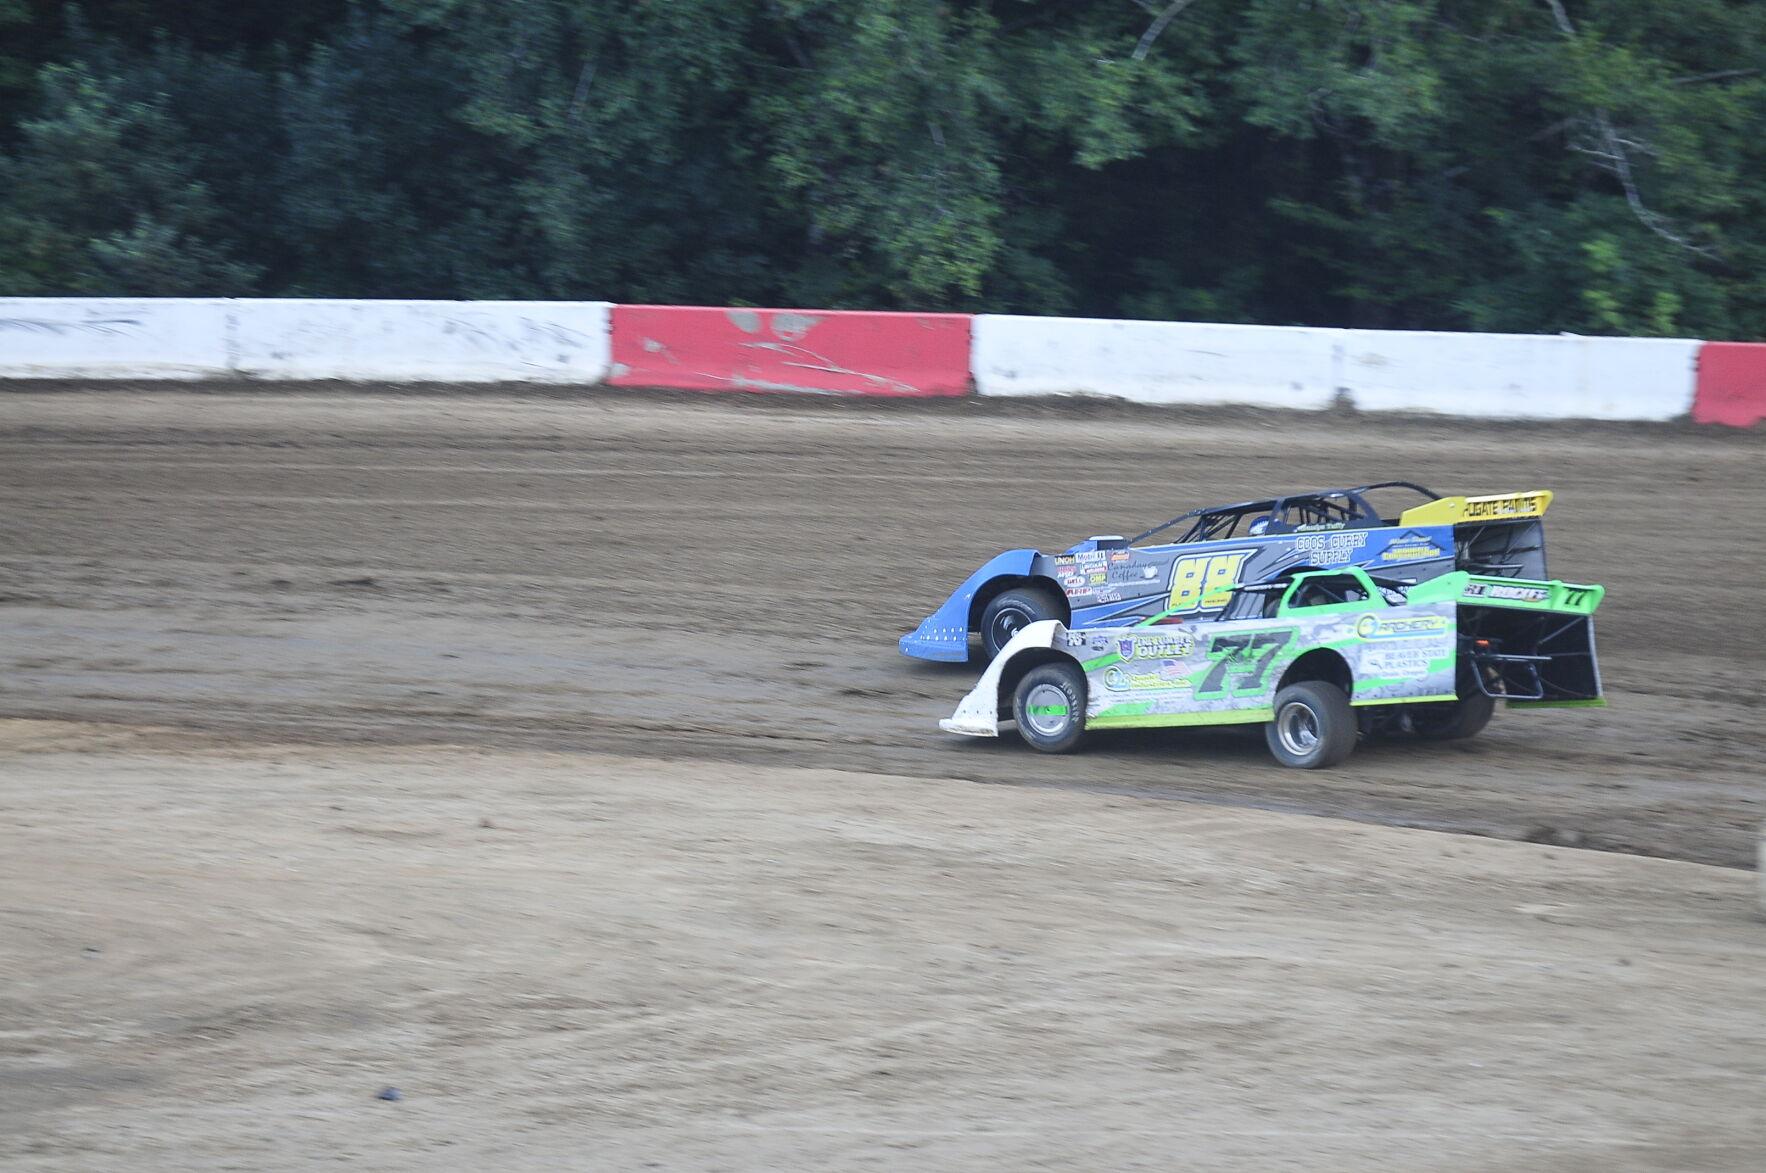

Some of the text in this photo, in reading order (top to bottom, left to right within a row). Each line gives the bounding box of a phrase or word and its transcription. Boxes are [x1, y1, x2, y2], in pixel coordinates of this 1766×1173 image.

[1297, 532, 1368, 551] COOS CURRY
[1055, 555, 1076, 565] UNOH
[1310, 549, 1353, 565] SUPPLY
[1090, 575, 1106, 583] OMP
[1166, 552, 1249, 613] 88
[1565, 588, 1587, 606] 77
[1139, 644, 1191, 658] OUTLET
[1196, 628, 1297, 697] 77
[1384, 659, 1428, 669] PLASTICS
